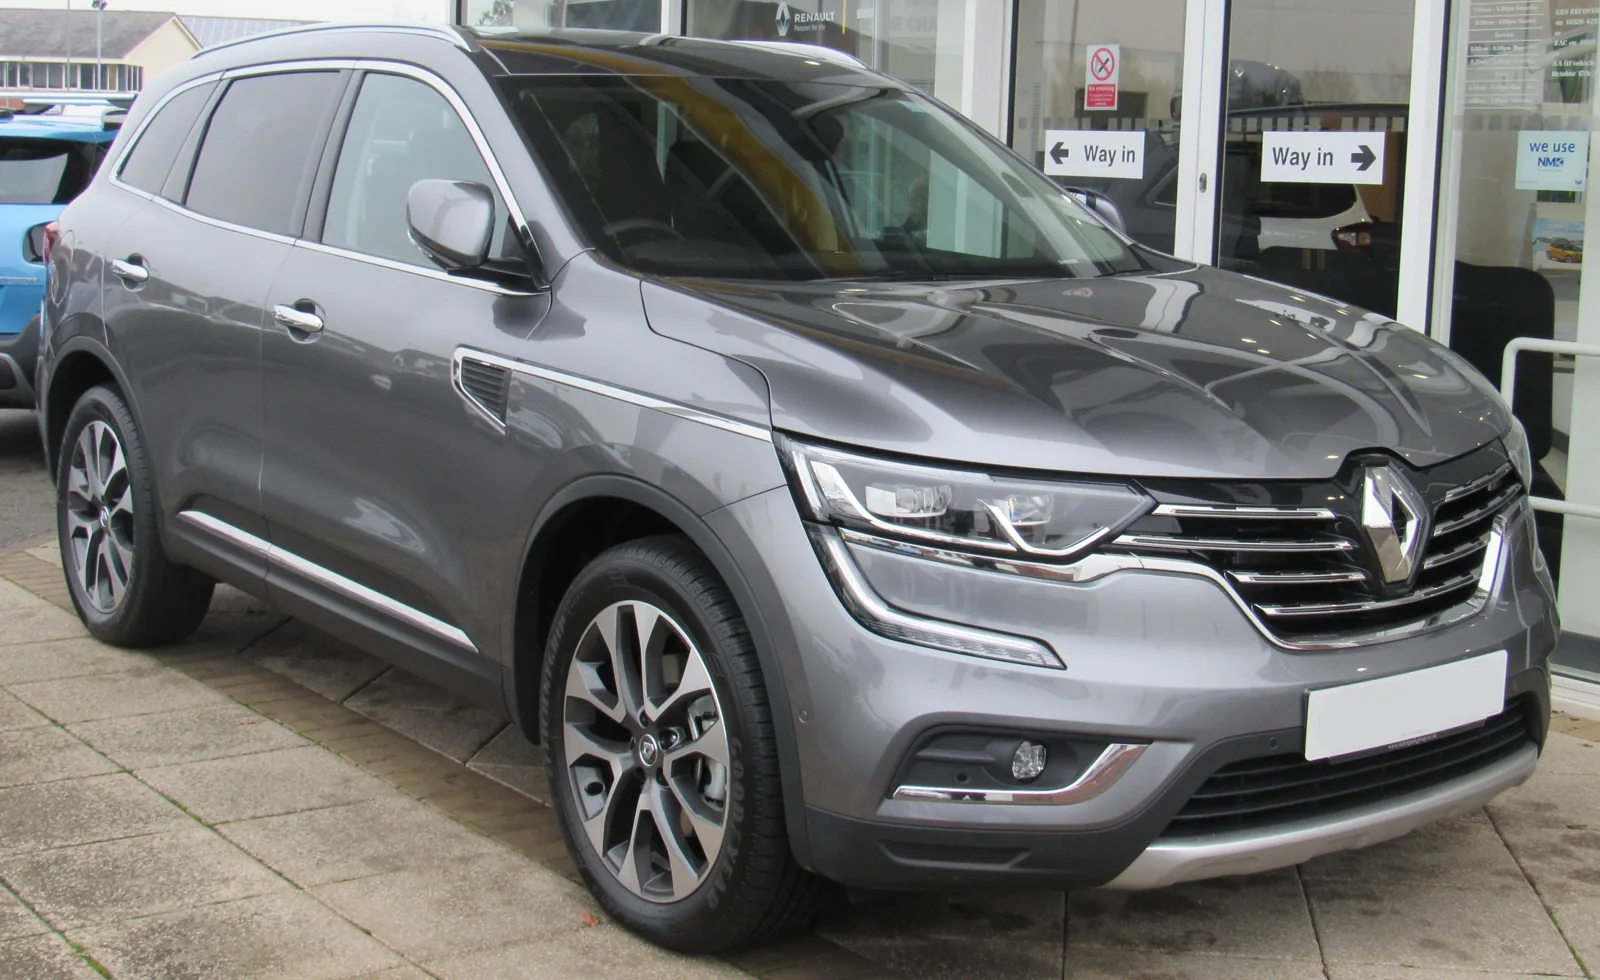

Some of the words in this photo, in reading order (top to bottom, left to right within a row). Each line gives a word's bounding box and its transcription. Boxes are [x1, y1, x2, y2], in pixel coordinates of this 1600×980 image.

[794, 12, 835, 23] RENAULT
[1084, 145, 1117, 167] Way
[1122, 145, 1136, 163] in
[1272, 147, 1311, 171] Way
[1317, 147, 1334, 166] in
[1529, 143, 1549, 152] we
[1553, 143, 1575, 153] use
[706, 737, 745, 908] GOODYEAR
